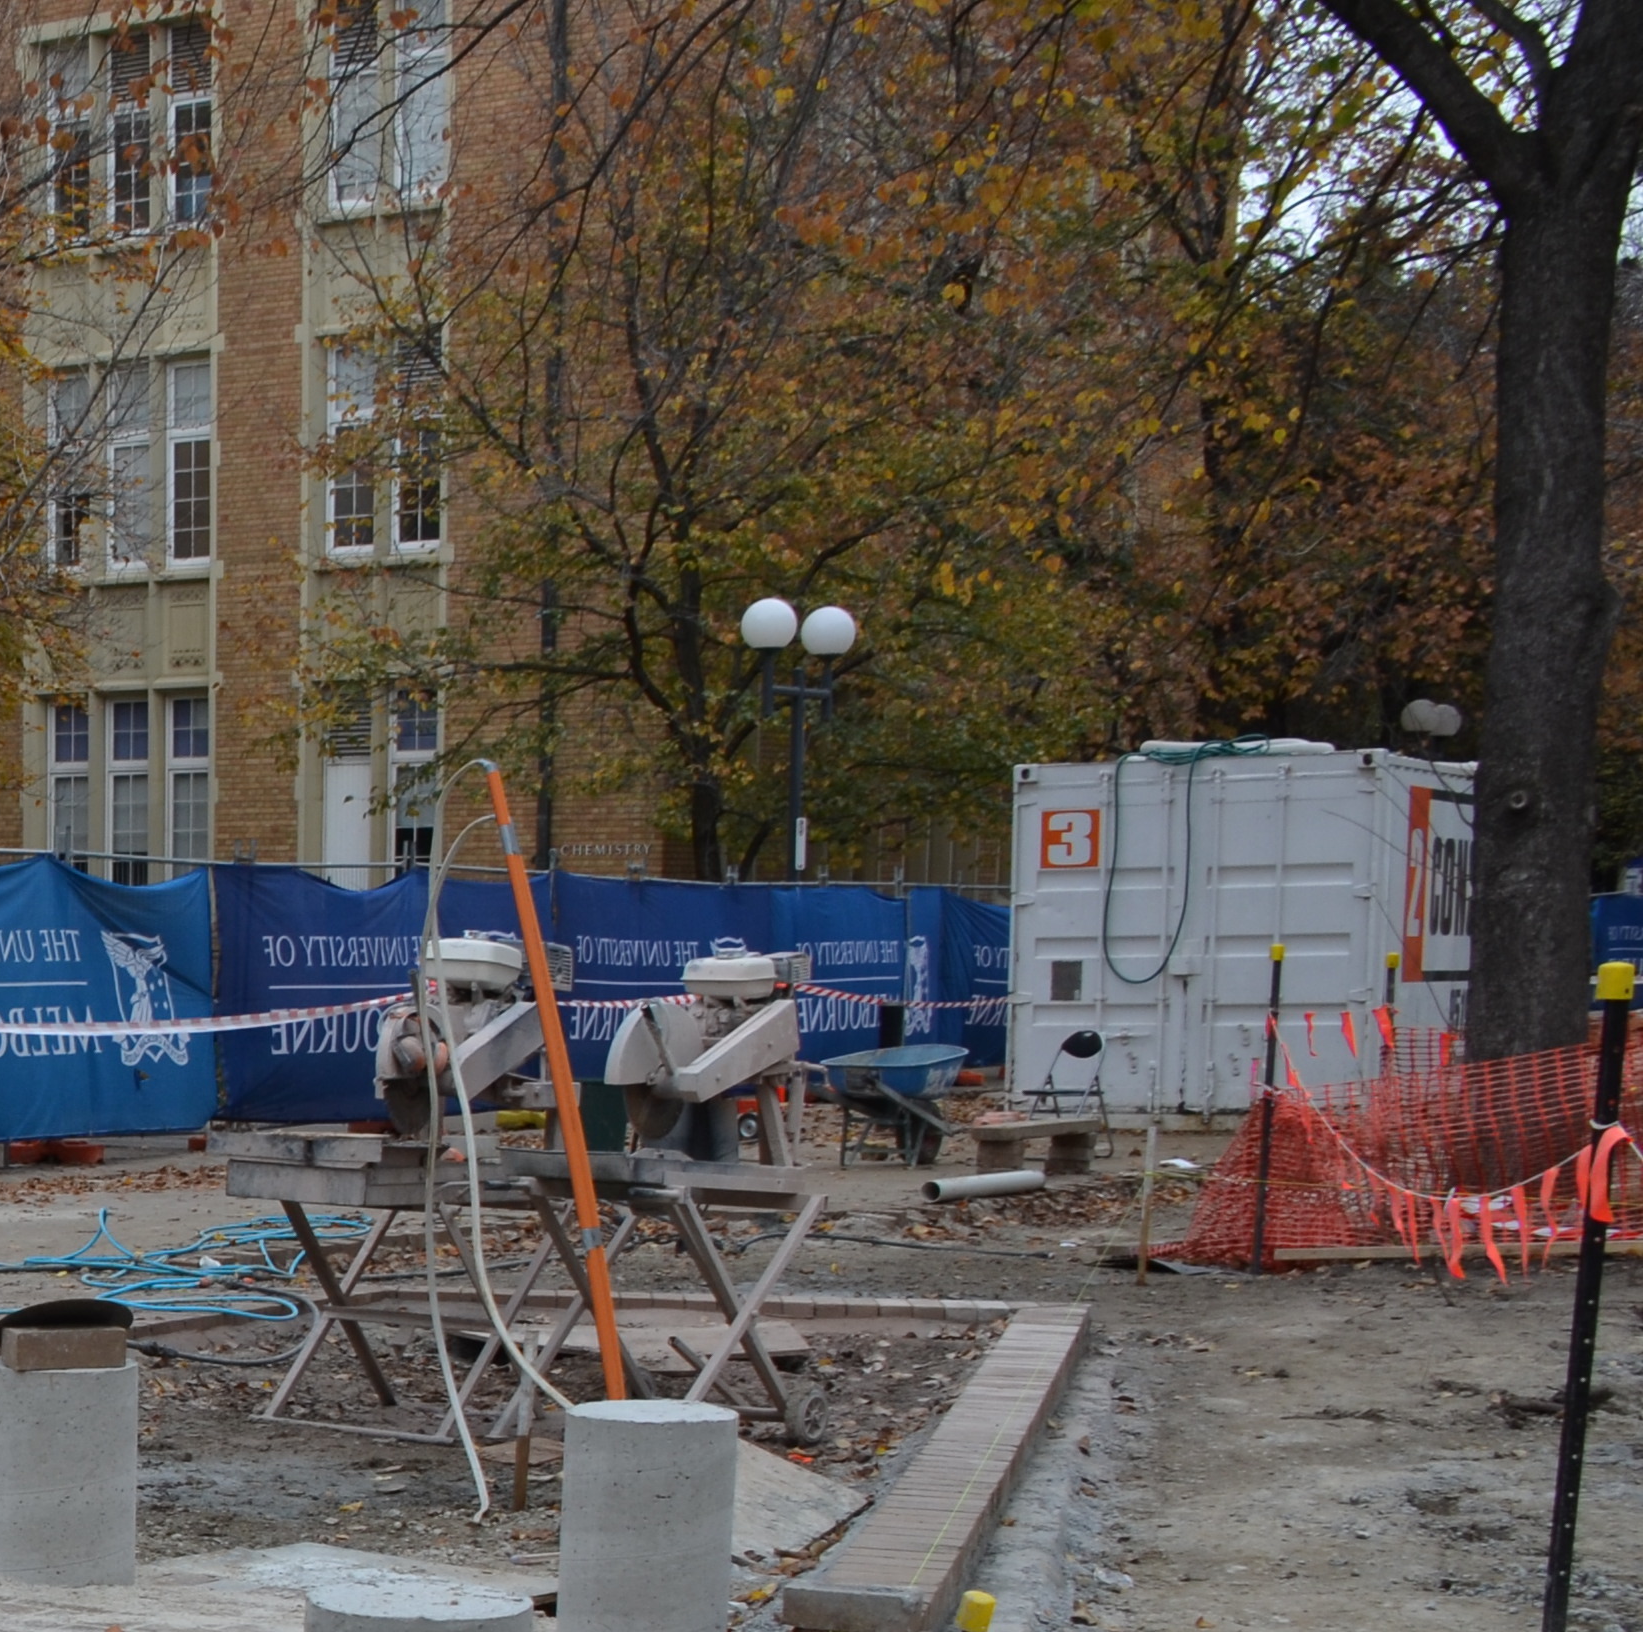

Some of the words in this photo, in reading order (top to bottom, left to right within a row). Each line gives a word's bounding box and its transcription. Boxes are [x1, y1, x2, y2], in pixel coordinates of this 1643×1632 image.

[560, 844, 651, 856] CHEMISTRY
[1048, 812, 1092, 865] 3
[1406, 828, 1424, 937] 2
[1429, 837, 1474, 936] CON
